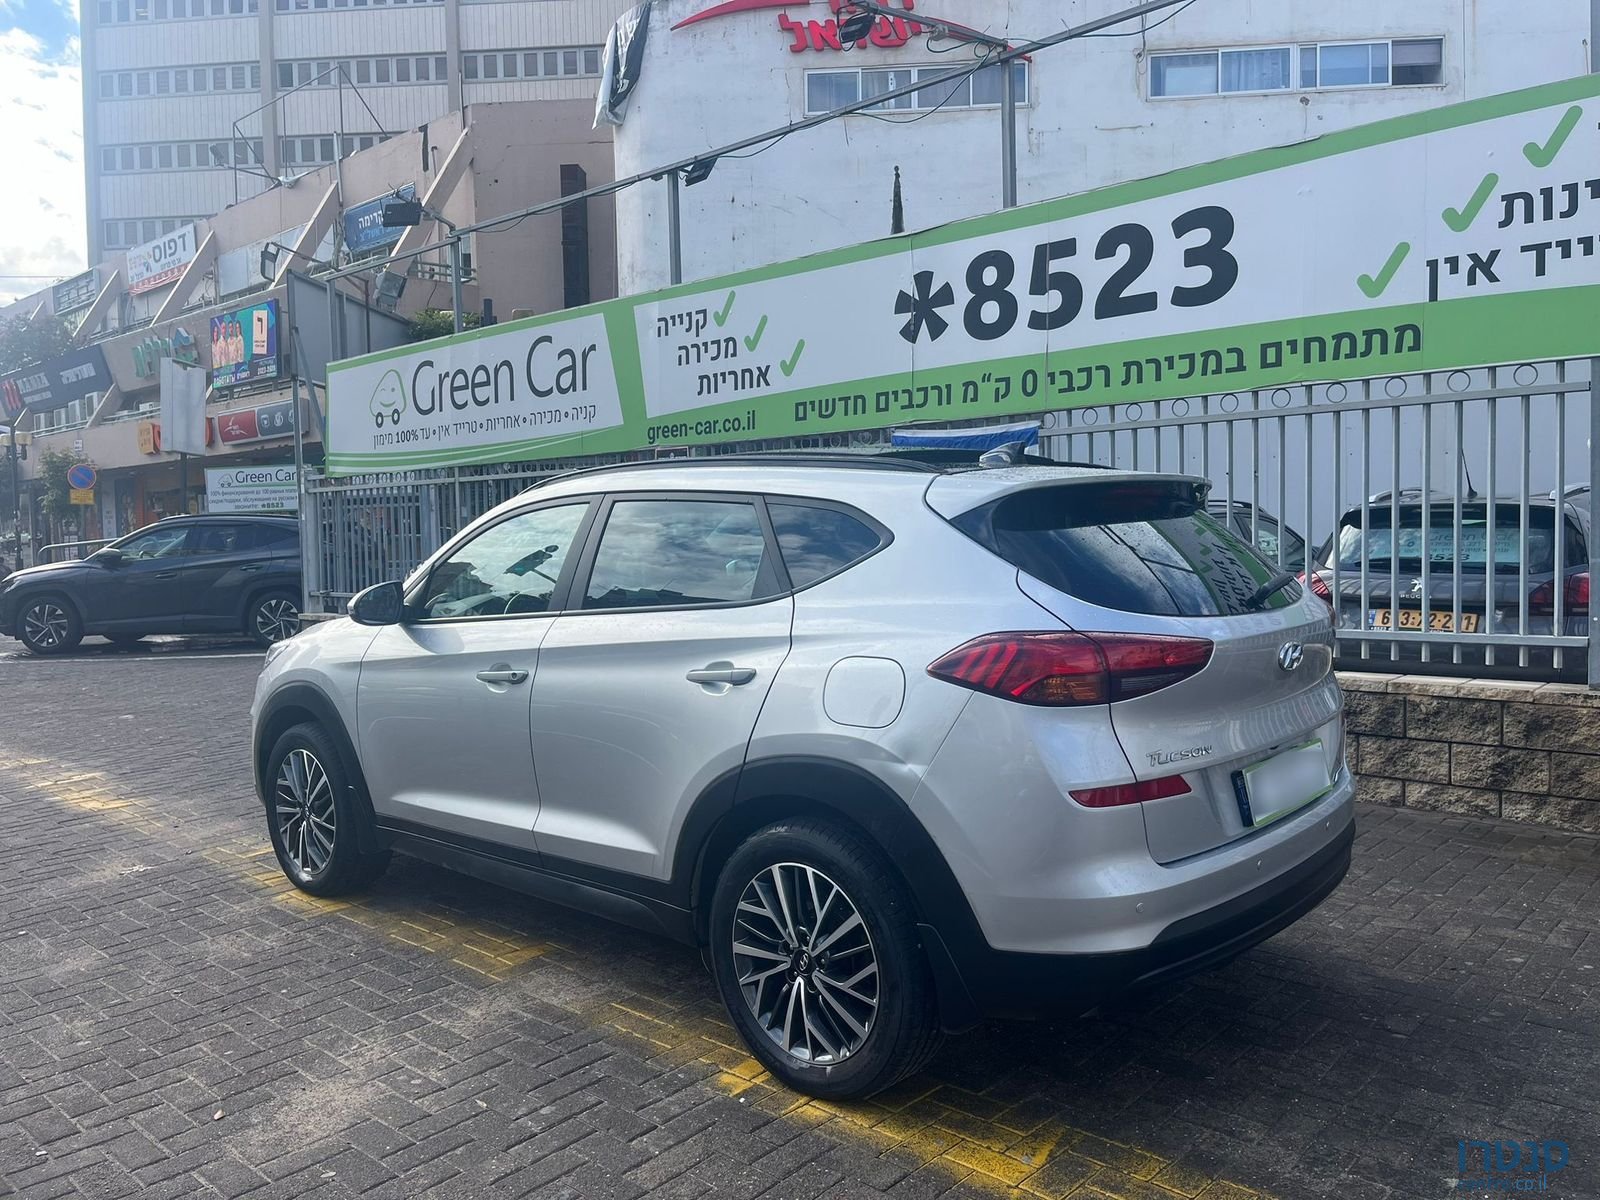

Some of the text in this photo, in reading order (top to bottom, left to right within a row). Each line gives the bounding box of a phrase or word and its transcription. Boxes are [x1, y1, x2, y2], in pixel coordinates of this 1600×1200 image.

[152, 231, 187, 264] דפוס
[1426, 234, 1600, 303] ייד אין
[656, 308, 708, 338] קנייה
[677, 336, 738, 366] מכירה
[1260, 323, 1421, 370] מתמחים
[412, 335, 597, 416] Green Car
[697, 364, 771, 396] אחריות
[1047, 363, 1111, 393] רכבי
[1121, 346, 1247, 386] במכירת
[794, 394, 866, 422] חדשים
[875, 383, 952, 414] ורכבים
[373, 404, 597, 450] קניה מכירה אחריות טרייד אין עד 100% מימון
[647, 410, 756, 444] green-car.co.il
[235, 468, 297, 483] Green Car
[1146, 745, 1213, 767] TUCSON
